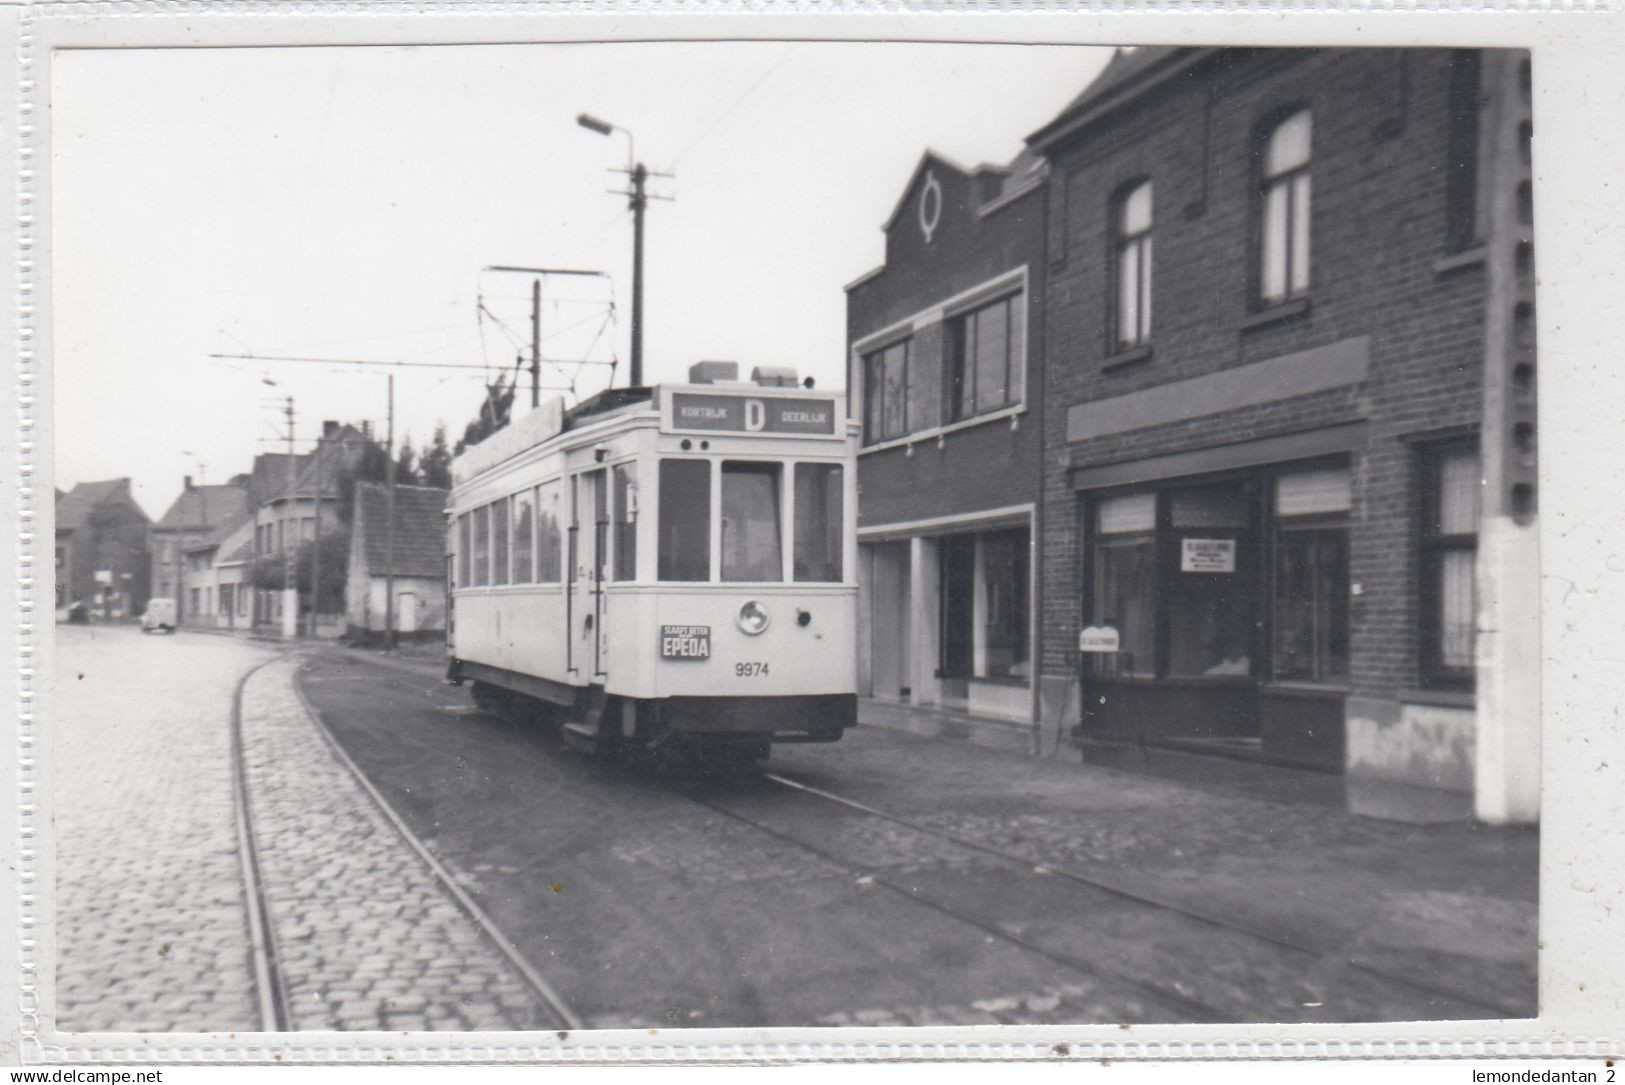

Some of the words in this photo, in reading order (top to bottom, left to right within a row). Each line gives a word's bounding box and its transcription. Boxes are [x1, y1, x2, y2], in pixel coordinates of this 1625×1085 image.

[680, 407, 728, 419] KORTRIJK
[744, 399, 766, 432] D
[781, 411, 826, 424] DEERLIJK
[689, 627, 708, 636] BETER
[663, 637, 709, 657] EPEDA
[735, 662, 769, 677] 9974
